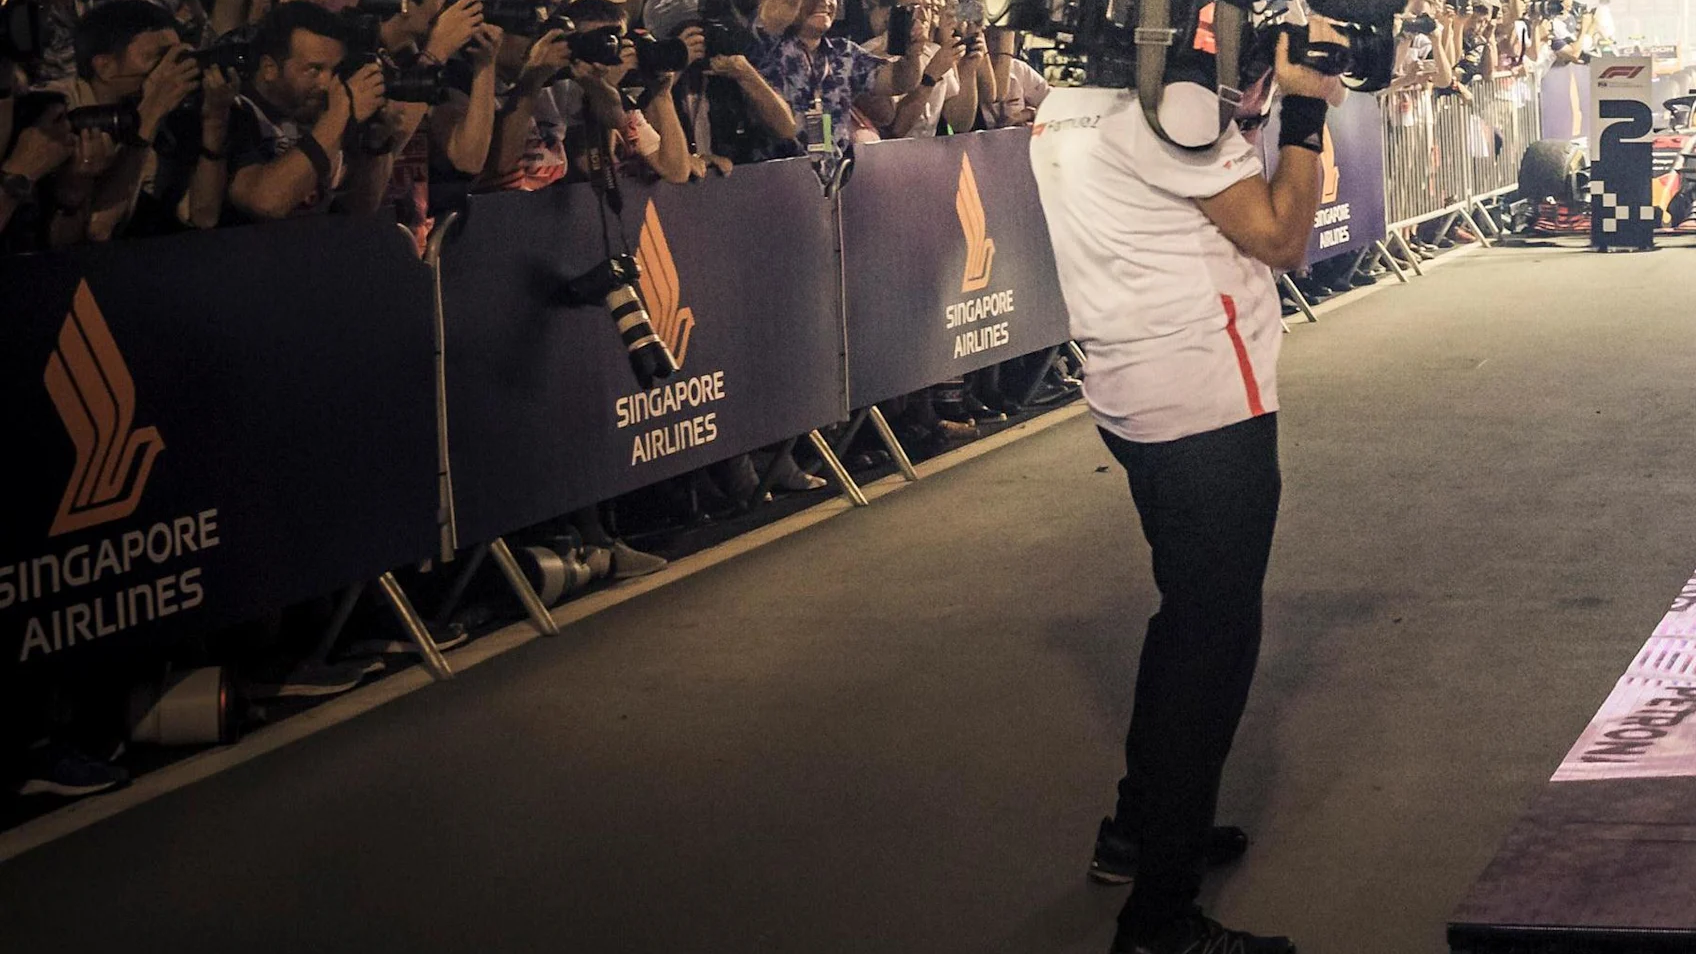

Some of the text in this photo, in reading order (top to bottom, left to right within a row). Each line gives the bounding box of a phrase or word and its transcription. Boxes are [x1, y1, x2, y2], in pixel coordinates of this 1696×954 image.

[1313, 203, 1351, 228] SINGAPORE
[1319, 225, 1350, 249] AIRLINES
[946, 289, 1014, 329] SINGAPORE
[953, 321, 1009, 360] AIRLINES
[616, 370, 726, 428] SINGAPORE
[631, 412, 718, 466] AIRLINES
[0, 508, 220, 610] SINGAPORE
[19, 567, 204, 662] AIRLINES
